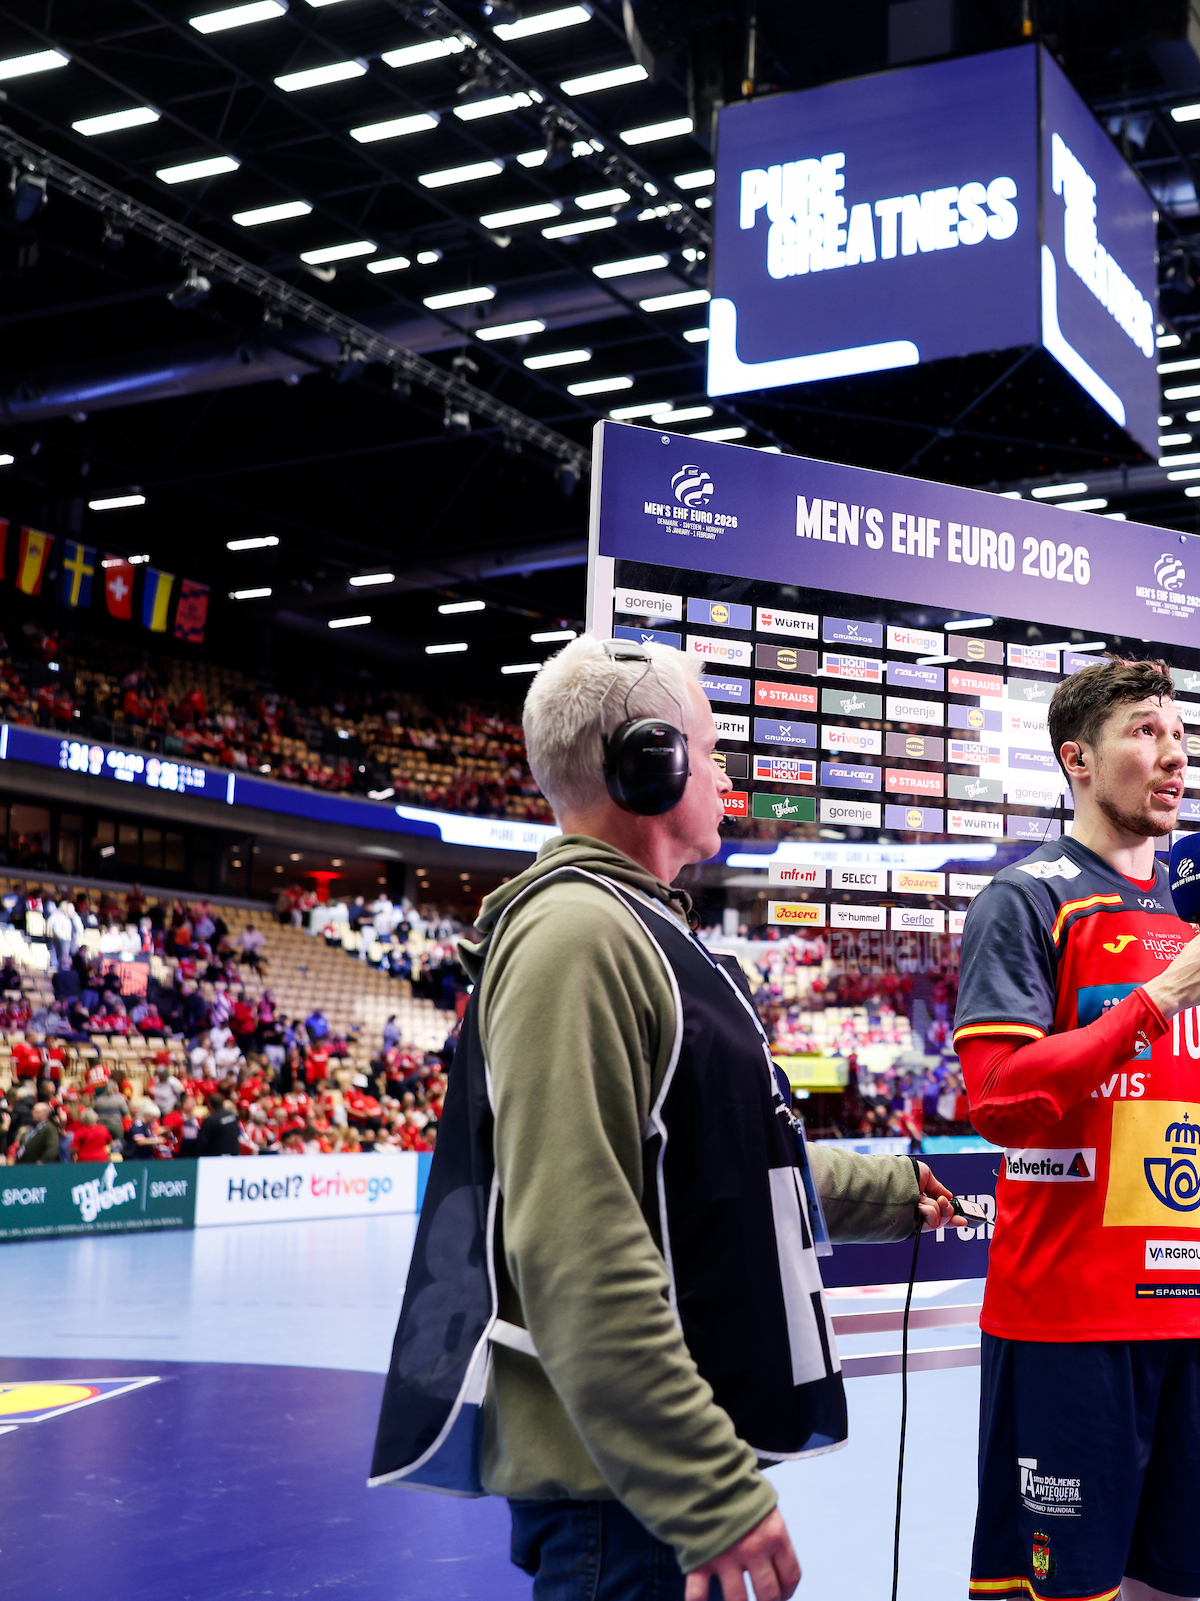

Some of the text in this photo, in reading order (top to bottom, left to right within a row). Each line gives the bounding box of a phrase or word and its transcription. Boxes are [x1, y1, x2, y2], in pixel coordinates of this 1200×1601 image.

[741, 152, 846, 229] PURE
[767, 176, 1018, 279] GREATNESS
[644, 501, 738, 529] MEN'S EHF EURO 2026
[796, 496, 1090, 586] MEN'S EHF EURO 2026
[1136, 586, 1156, 600] MEN'S
[1156, 590, 1168, 602] EHF
[1169, 592, 1186, 604] EURO
[625, 596, 672, 612] gorenje
[833, 633, 873, 643] GRUNDFOS
[894, 632, 937, 650] trivago
[694, 641, 742, 660] trivago
[1023, 648, 1045, 660] LIQUI
[777, 656, 797, 664] HARTING
[841, 658, 866, 669] LIQUI
[1023, 656, 1046, 668] MOLY
[841, 667, 866, 678] MOLY
[894, 668, 937, 680] FALKEN
[961, 678, 1001, 691] STRAUSS
[769, 690, 814, 703] STRAUSS
[844, 702, 866, 714] green
[895, 704, 936, 721] gorenje
[714, 721, 744, 732] ÜRTH
[764, 734, 806, 744] GRUNDFOS
[829, 732, 874, 748] trivago
[964, 744, 988, 754] LIQUI
[964, 752, 988, 762] MOLY
[1014, 752, 1054, 763] FALKEN
[772, 760, 798, 771] LIQUI
[772, 770, 798, 780] MOLY
[829, 769, 874, 780] FALKEN
[899, 777, 940, 790] STRAUSS
[1016, 788, 1052, 800] gorenje
[776, 805, 798, 818] green
[829, 806, 872, 819] gorenje
[842, 873, 878, 884] SELECT
[900, 876, 938, 888] Josera
[776, 908, 818, 920] Josera
[848, 913, 880, 922] hummel
[902, 913, 934, 926] Gerflor
[1007, 1156, 1064, 1176] helvetia
[150, 1180, 188, 1198] SPORT
[228, 1172, 392, 1202] Hotel? trivago
[2, 1187, 48, 1206] SPORT
[80, 1182, 136, 1222] green
[1044, 1476, 1080, 1487] DÓLMENES
[1036, 1484, 1079, 1498] ANTEQUERA
